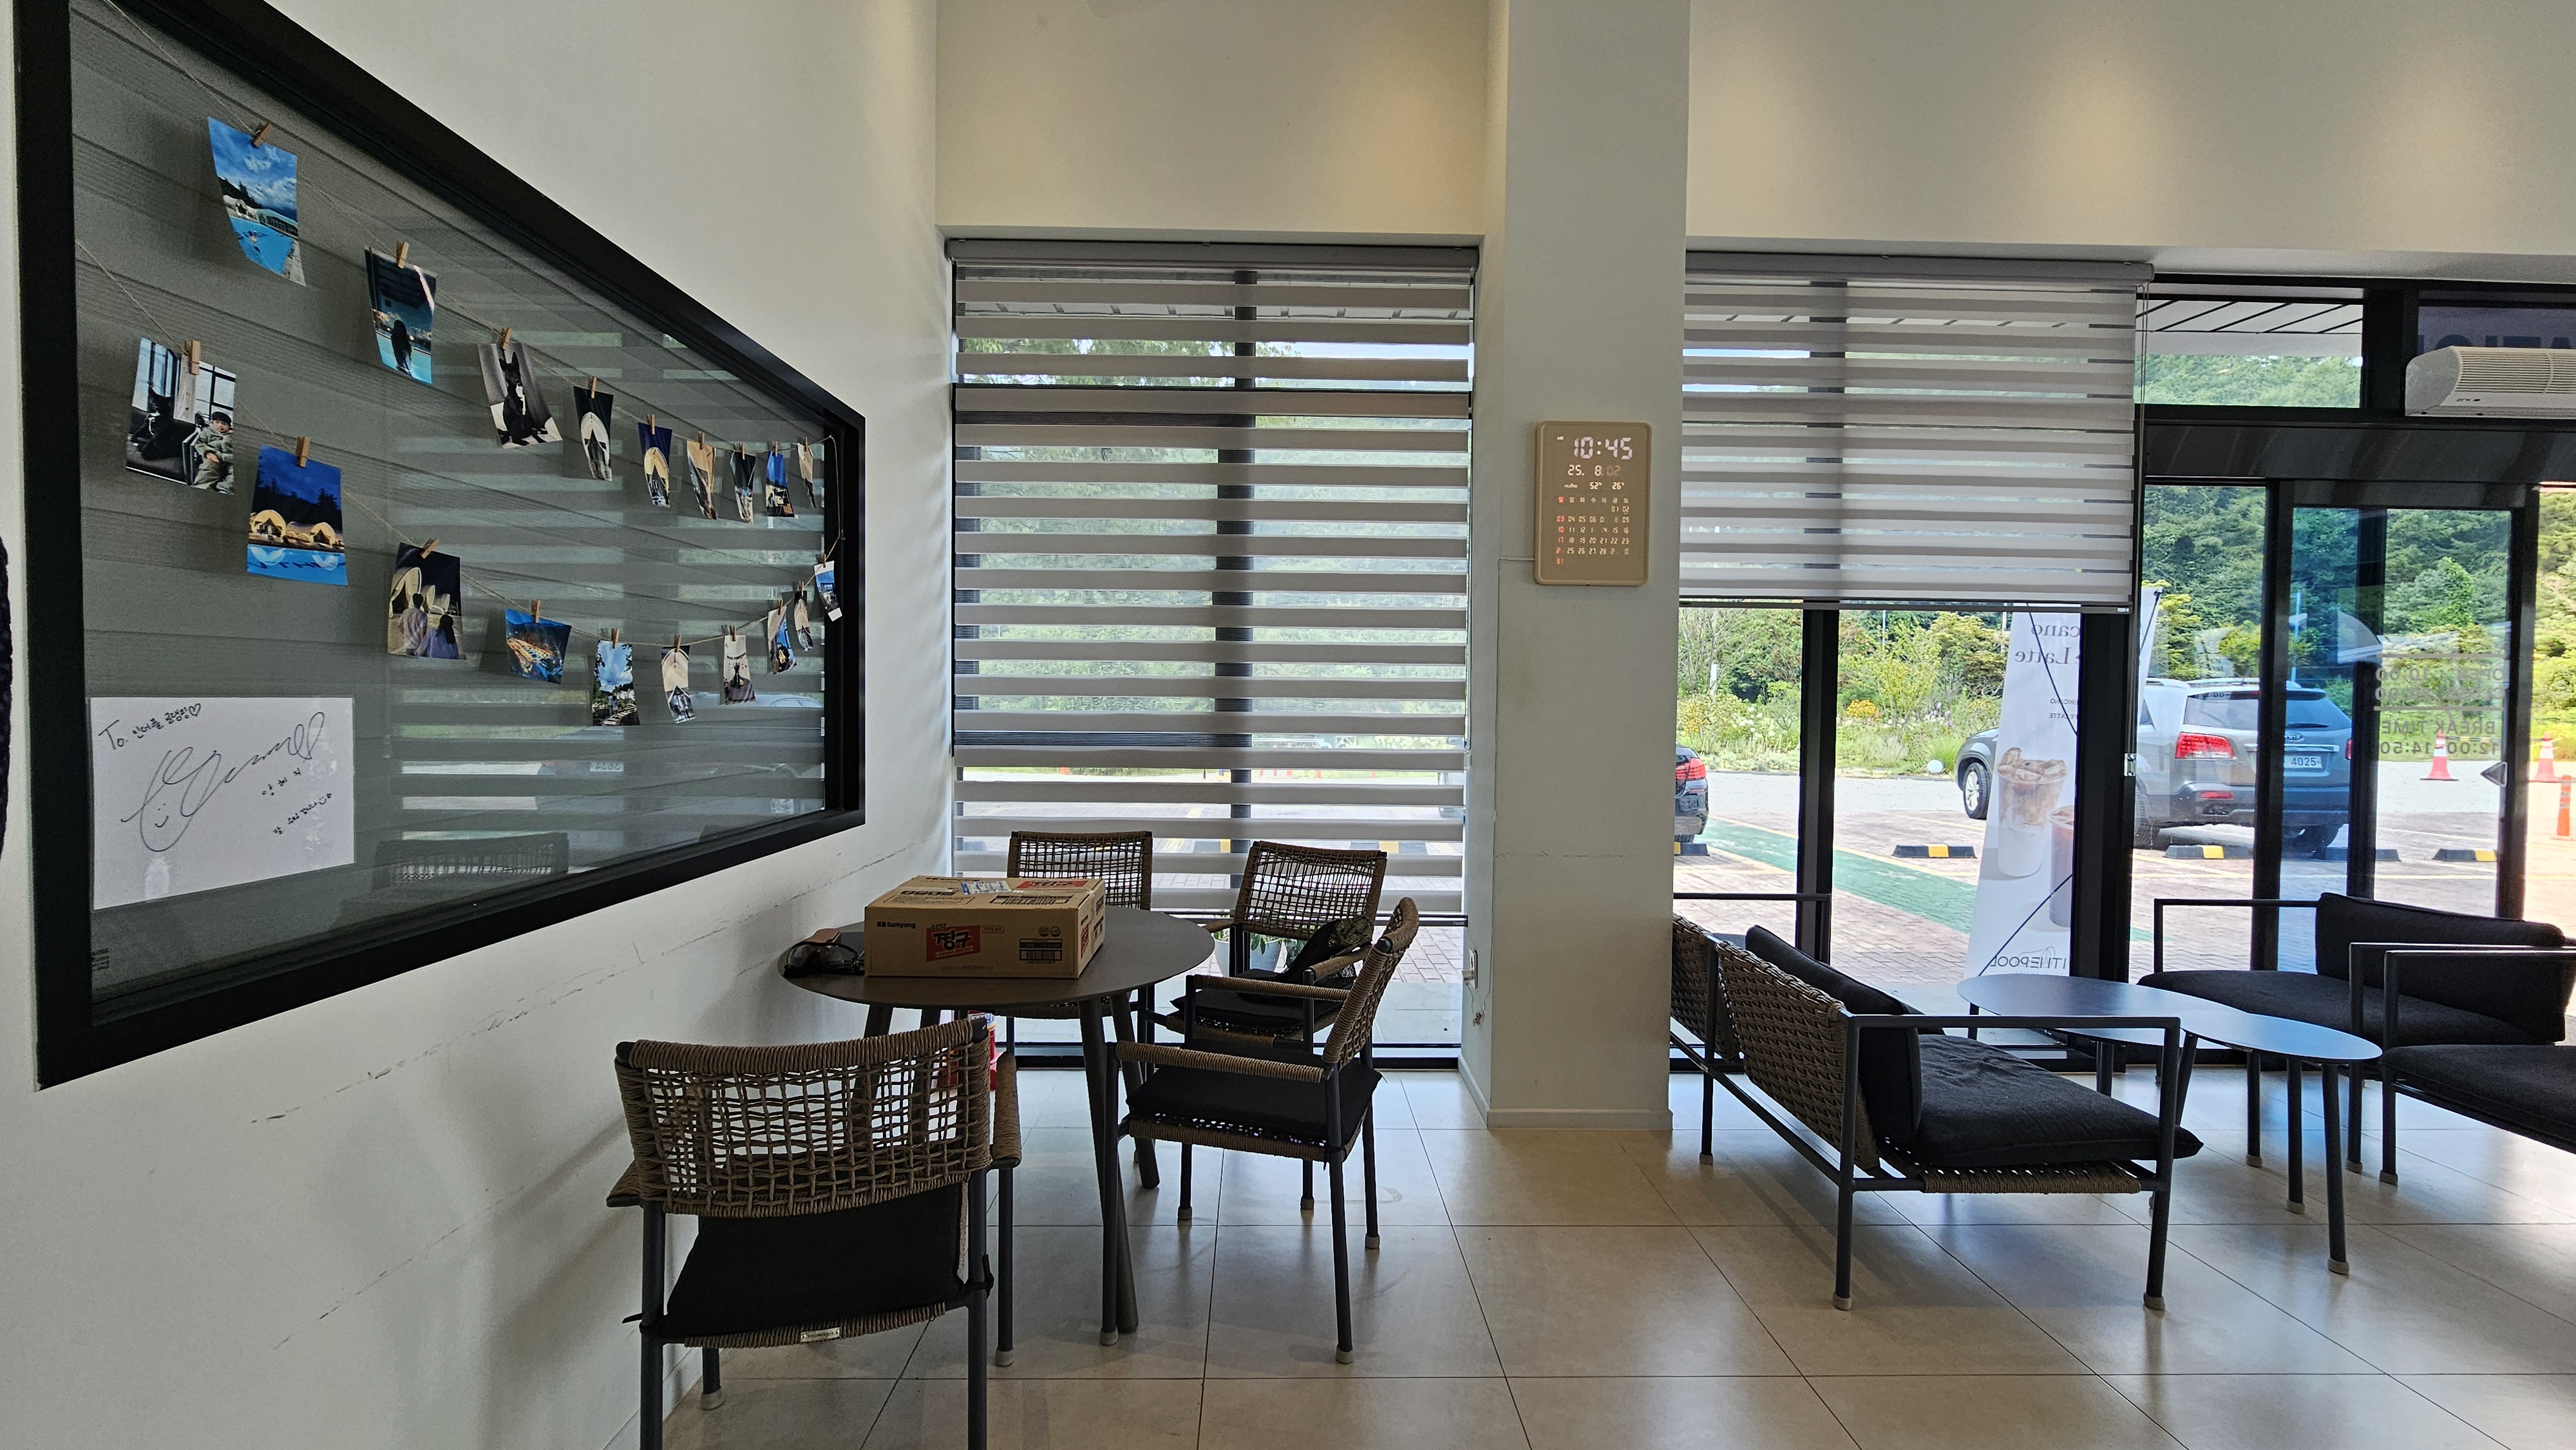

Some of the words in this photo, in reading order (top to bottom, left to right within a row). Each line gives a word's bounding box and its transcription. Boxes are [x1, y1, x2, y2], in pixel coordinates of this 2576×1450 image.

[1573, 437, 1633, 460] 10:45
[1568, 464, 1585, 476] 25.
[164, 706, 189, 724] 글램핑
[2291, 757, 2316, 766] 4025
[933, 929, 972, 951] 짱구
